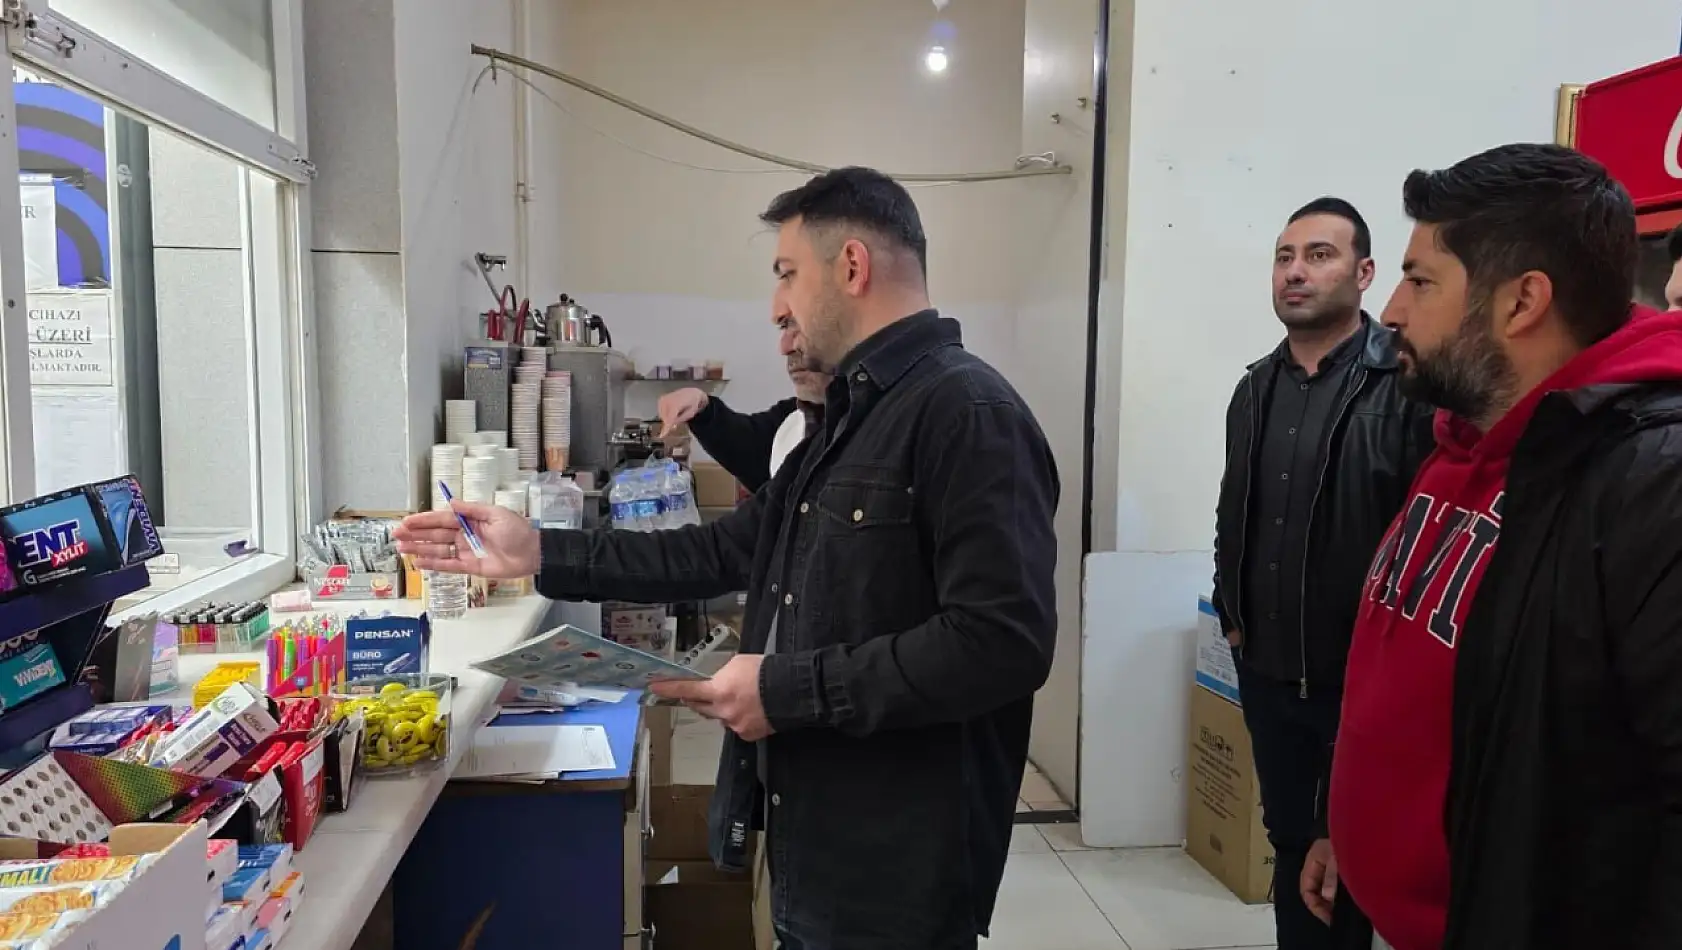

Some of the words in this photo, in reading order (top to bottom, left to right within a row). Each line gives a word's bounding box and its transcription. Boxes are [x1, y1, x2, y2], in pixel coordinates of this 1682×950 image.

[36, 326, 92, 341] ÜZERİ
[53, 542, 86, 565] XYLIT
[354, 629, 410, 640] PENSAN
